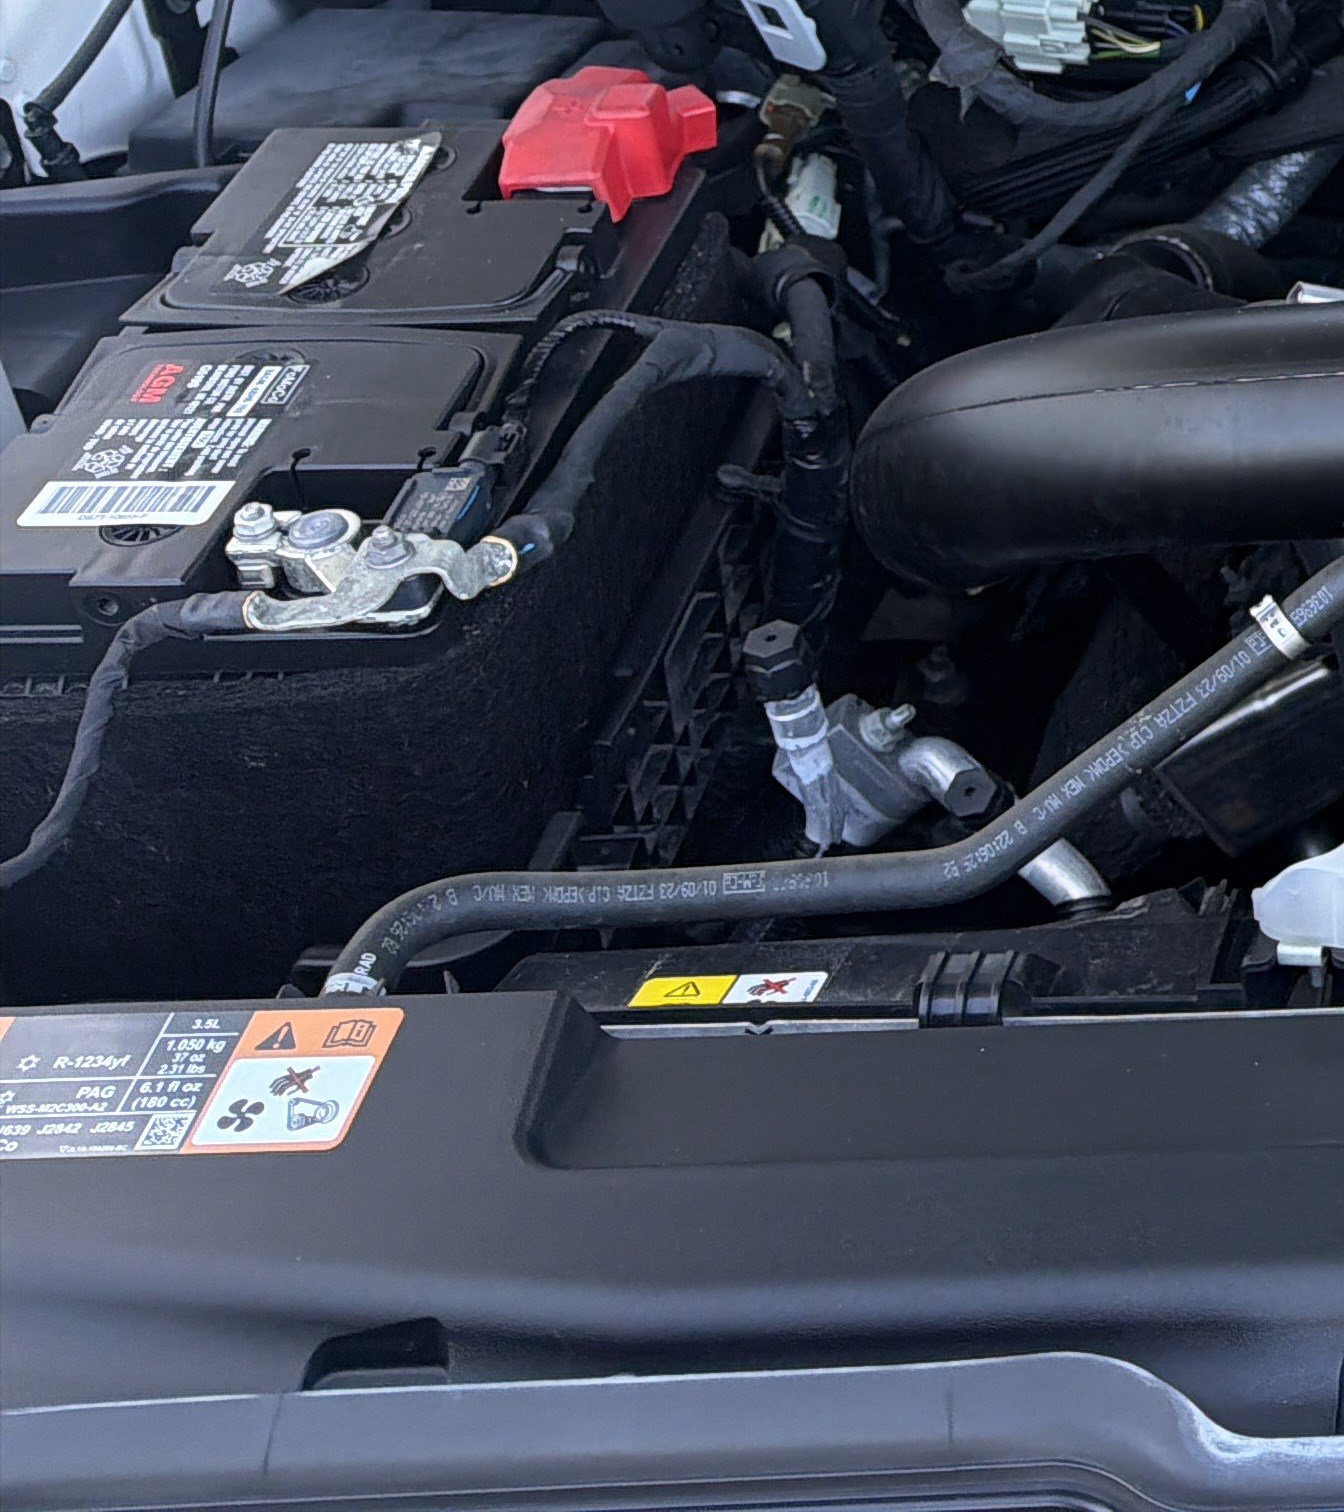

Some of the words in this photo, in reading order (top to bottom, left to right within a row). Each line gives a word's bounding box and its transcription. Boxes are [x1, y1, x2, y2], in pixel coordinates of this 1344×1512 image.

[138, 364, 186, 404] AGM
[353, 952, 377, 976] RAD
[191, 1018, 221, 1030] 3.5L
[166, 1038, 206, 1052] 1.050
[206, 1038, 227, 1054] kg
[52, 1054, 133, 1071] R-1234yf
[171, 1052, 190, 1063] 37
[189, 1053, 207, 1063] oz
[157, 1063, 185, 1075] 2.31
[185, 1063, 207, 1075] lbs
[75, 1085, 117, 1099] PAG
[139, 1081, 165, 1094] 6.1
[167, 1080, 181, 1093] fl
[181, 1082, 204, 1093] oz
[131, 1096, 169, 1112] (180
[169, 1094, 197, 1110] cc)
[36, 1122, 83, 1136] J2842
[89, 1120, 136, 1134] J2845
